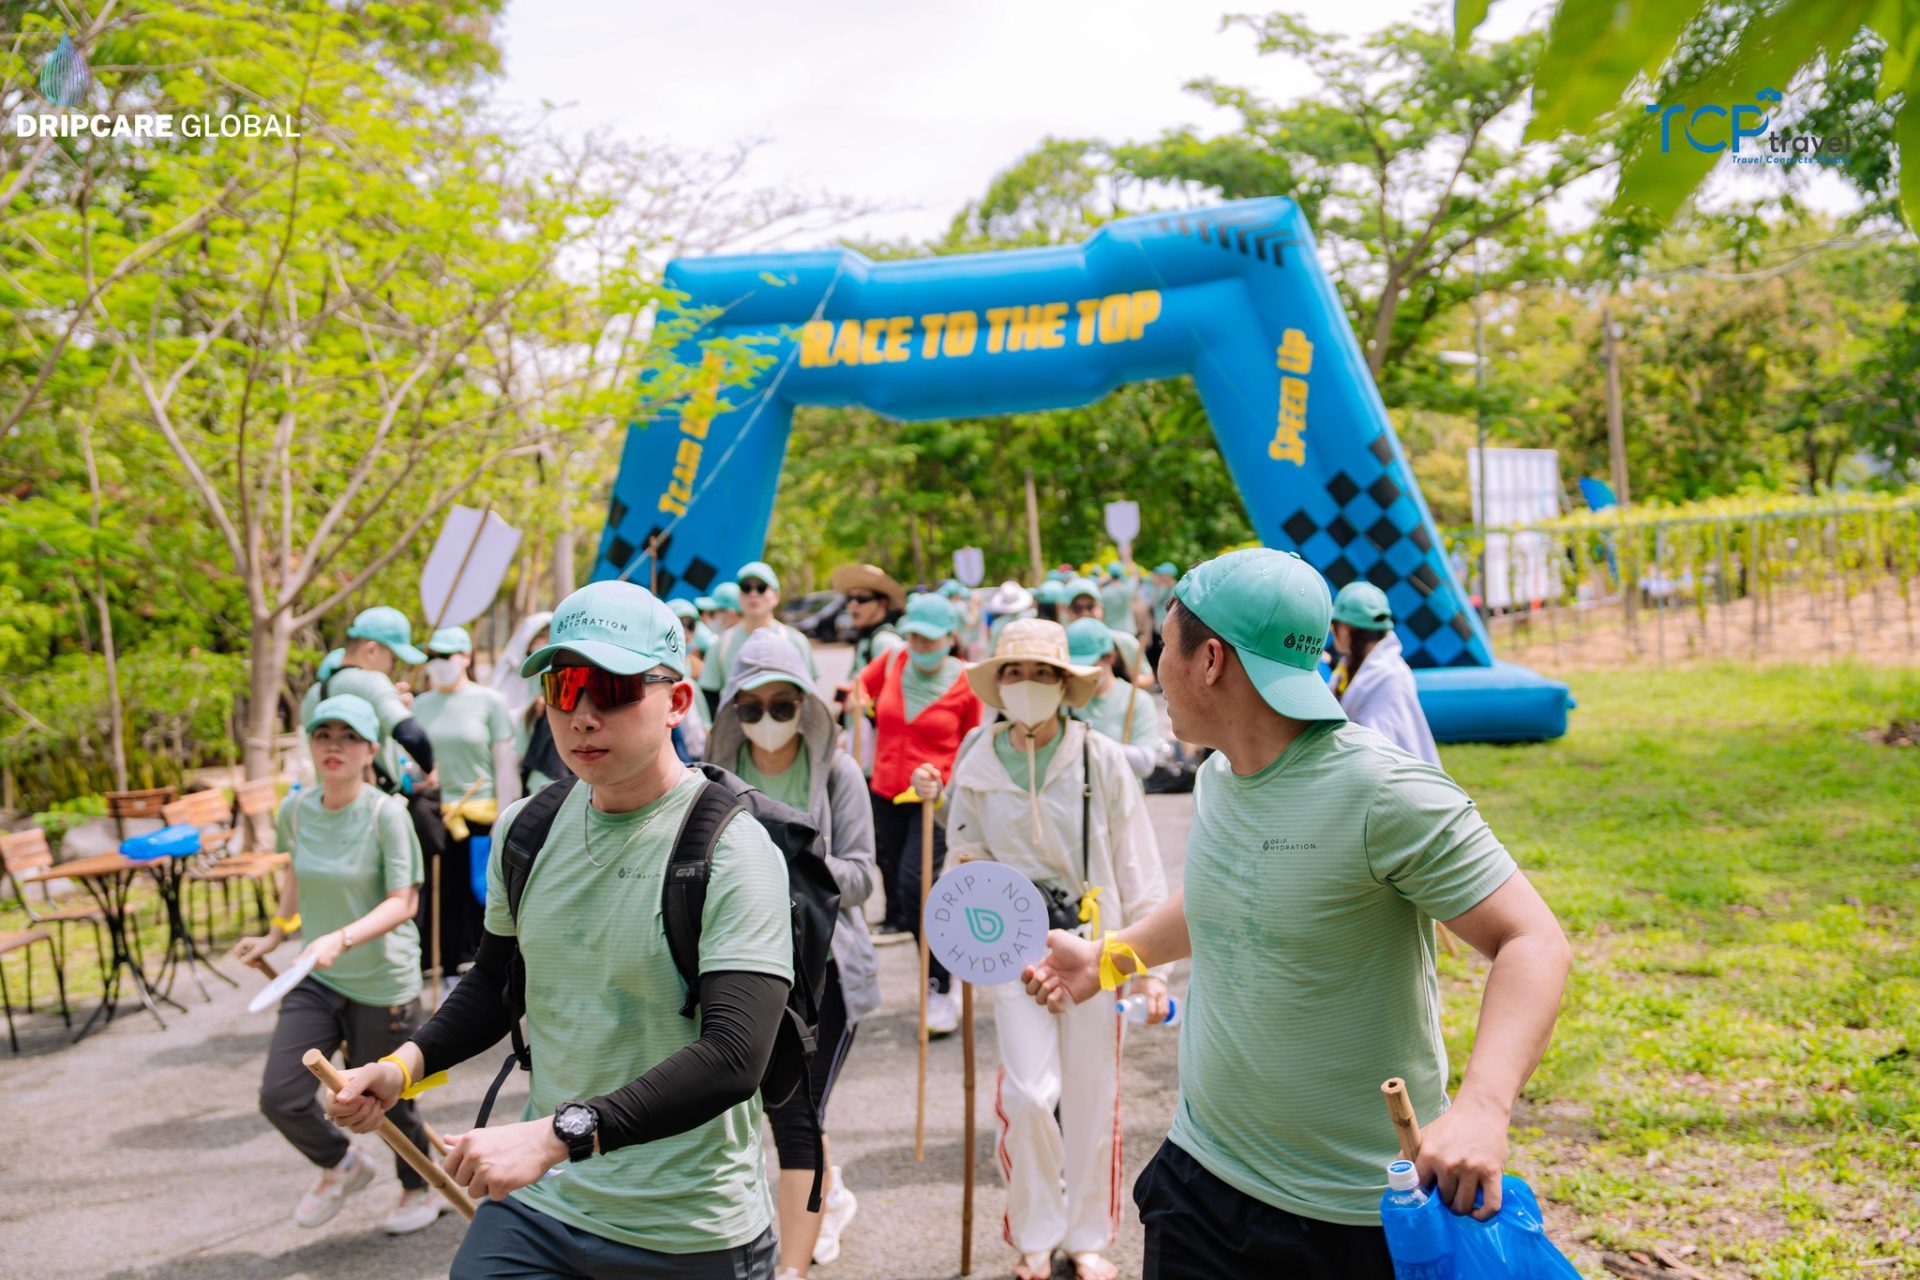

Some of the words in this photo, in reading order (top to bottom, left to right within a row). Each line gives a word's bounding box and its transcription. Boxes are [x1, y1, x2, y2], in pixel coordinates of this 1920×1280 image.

[799, 316, 914, 368] RACE
[921, 310, 978, 359] TO
[985, 302, 1069, 353] THE
[1076, 289, 1162, 345] TOP
[563, 618, 628, 632] HYDRATION
[564, 610, 587, 623] DRIP
[1298, 634, 1321, 645] DRIP
[934, 875, 975, 921] DRIP
[948, 882, 1034, 973] HYDRATION
